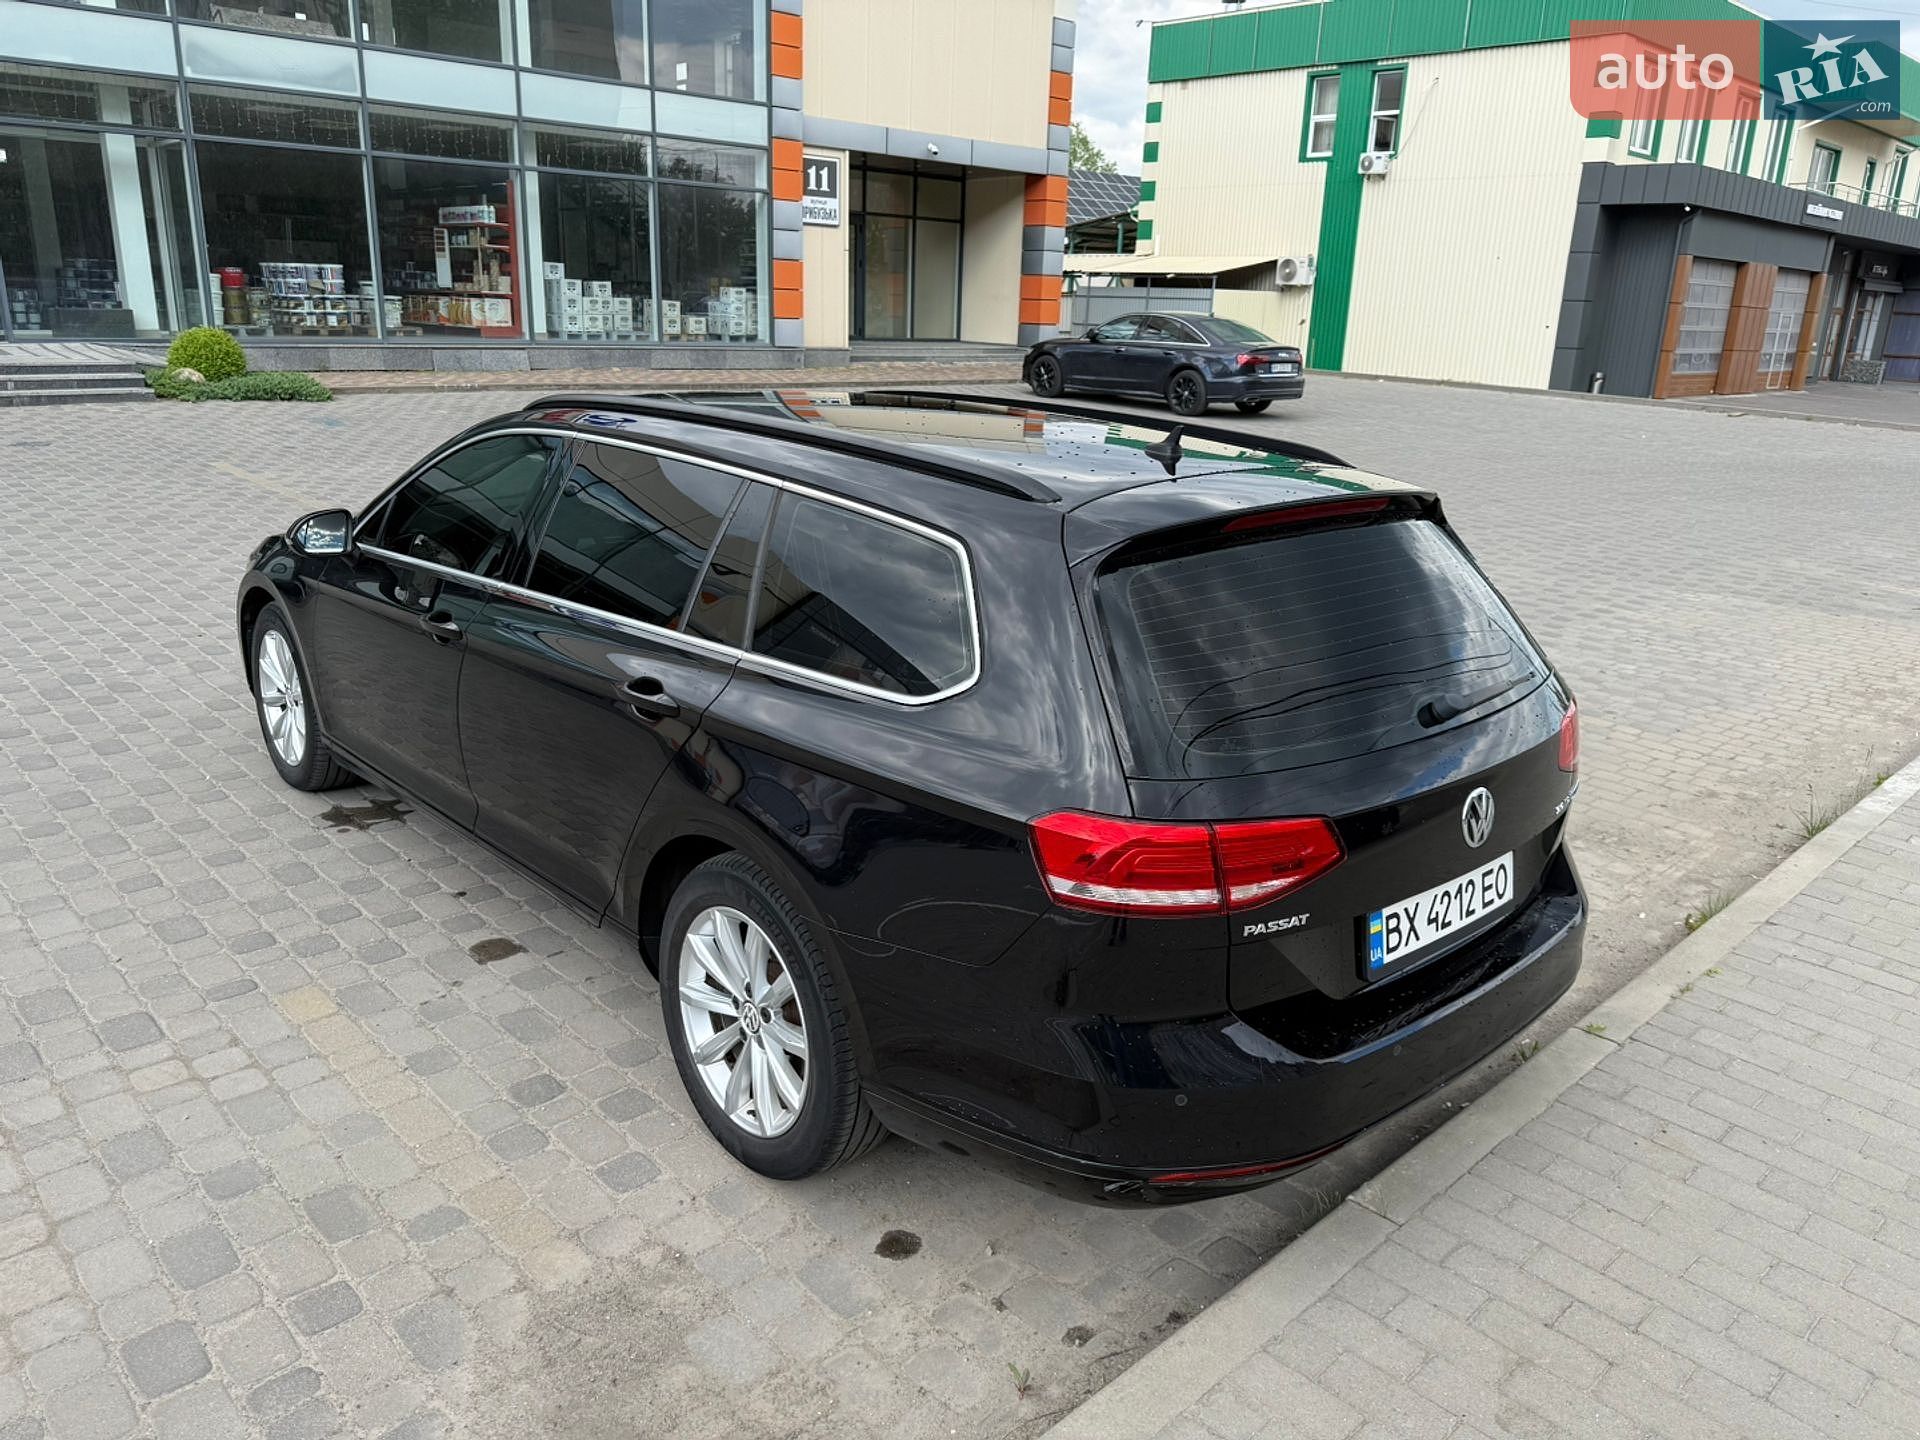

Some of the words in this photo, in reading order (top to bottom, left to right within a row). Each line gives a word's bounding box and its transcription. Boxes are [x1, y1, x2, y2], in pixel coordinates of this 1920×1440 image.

[807, 165, 831, 192] 11
[1385, 902, 1420, 955] BX
[1427, 878, 1476, 932] 4212
[1481, 863, 1508, 910] EO
[1243, 913, 1310, 937] PASSAT
[1370, 947, 1383, 961] UA
